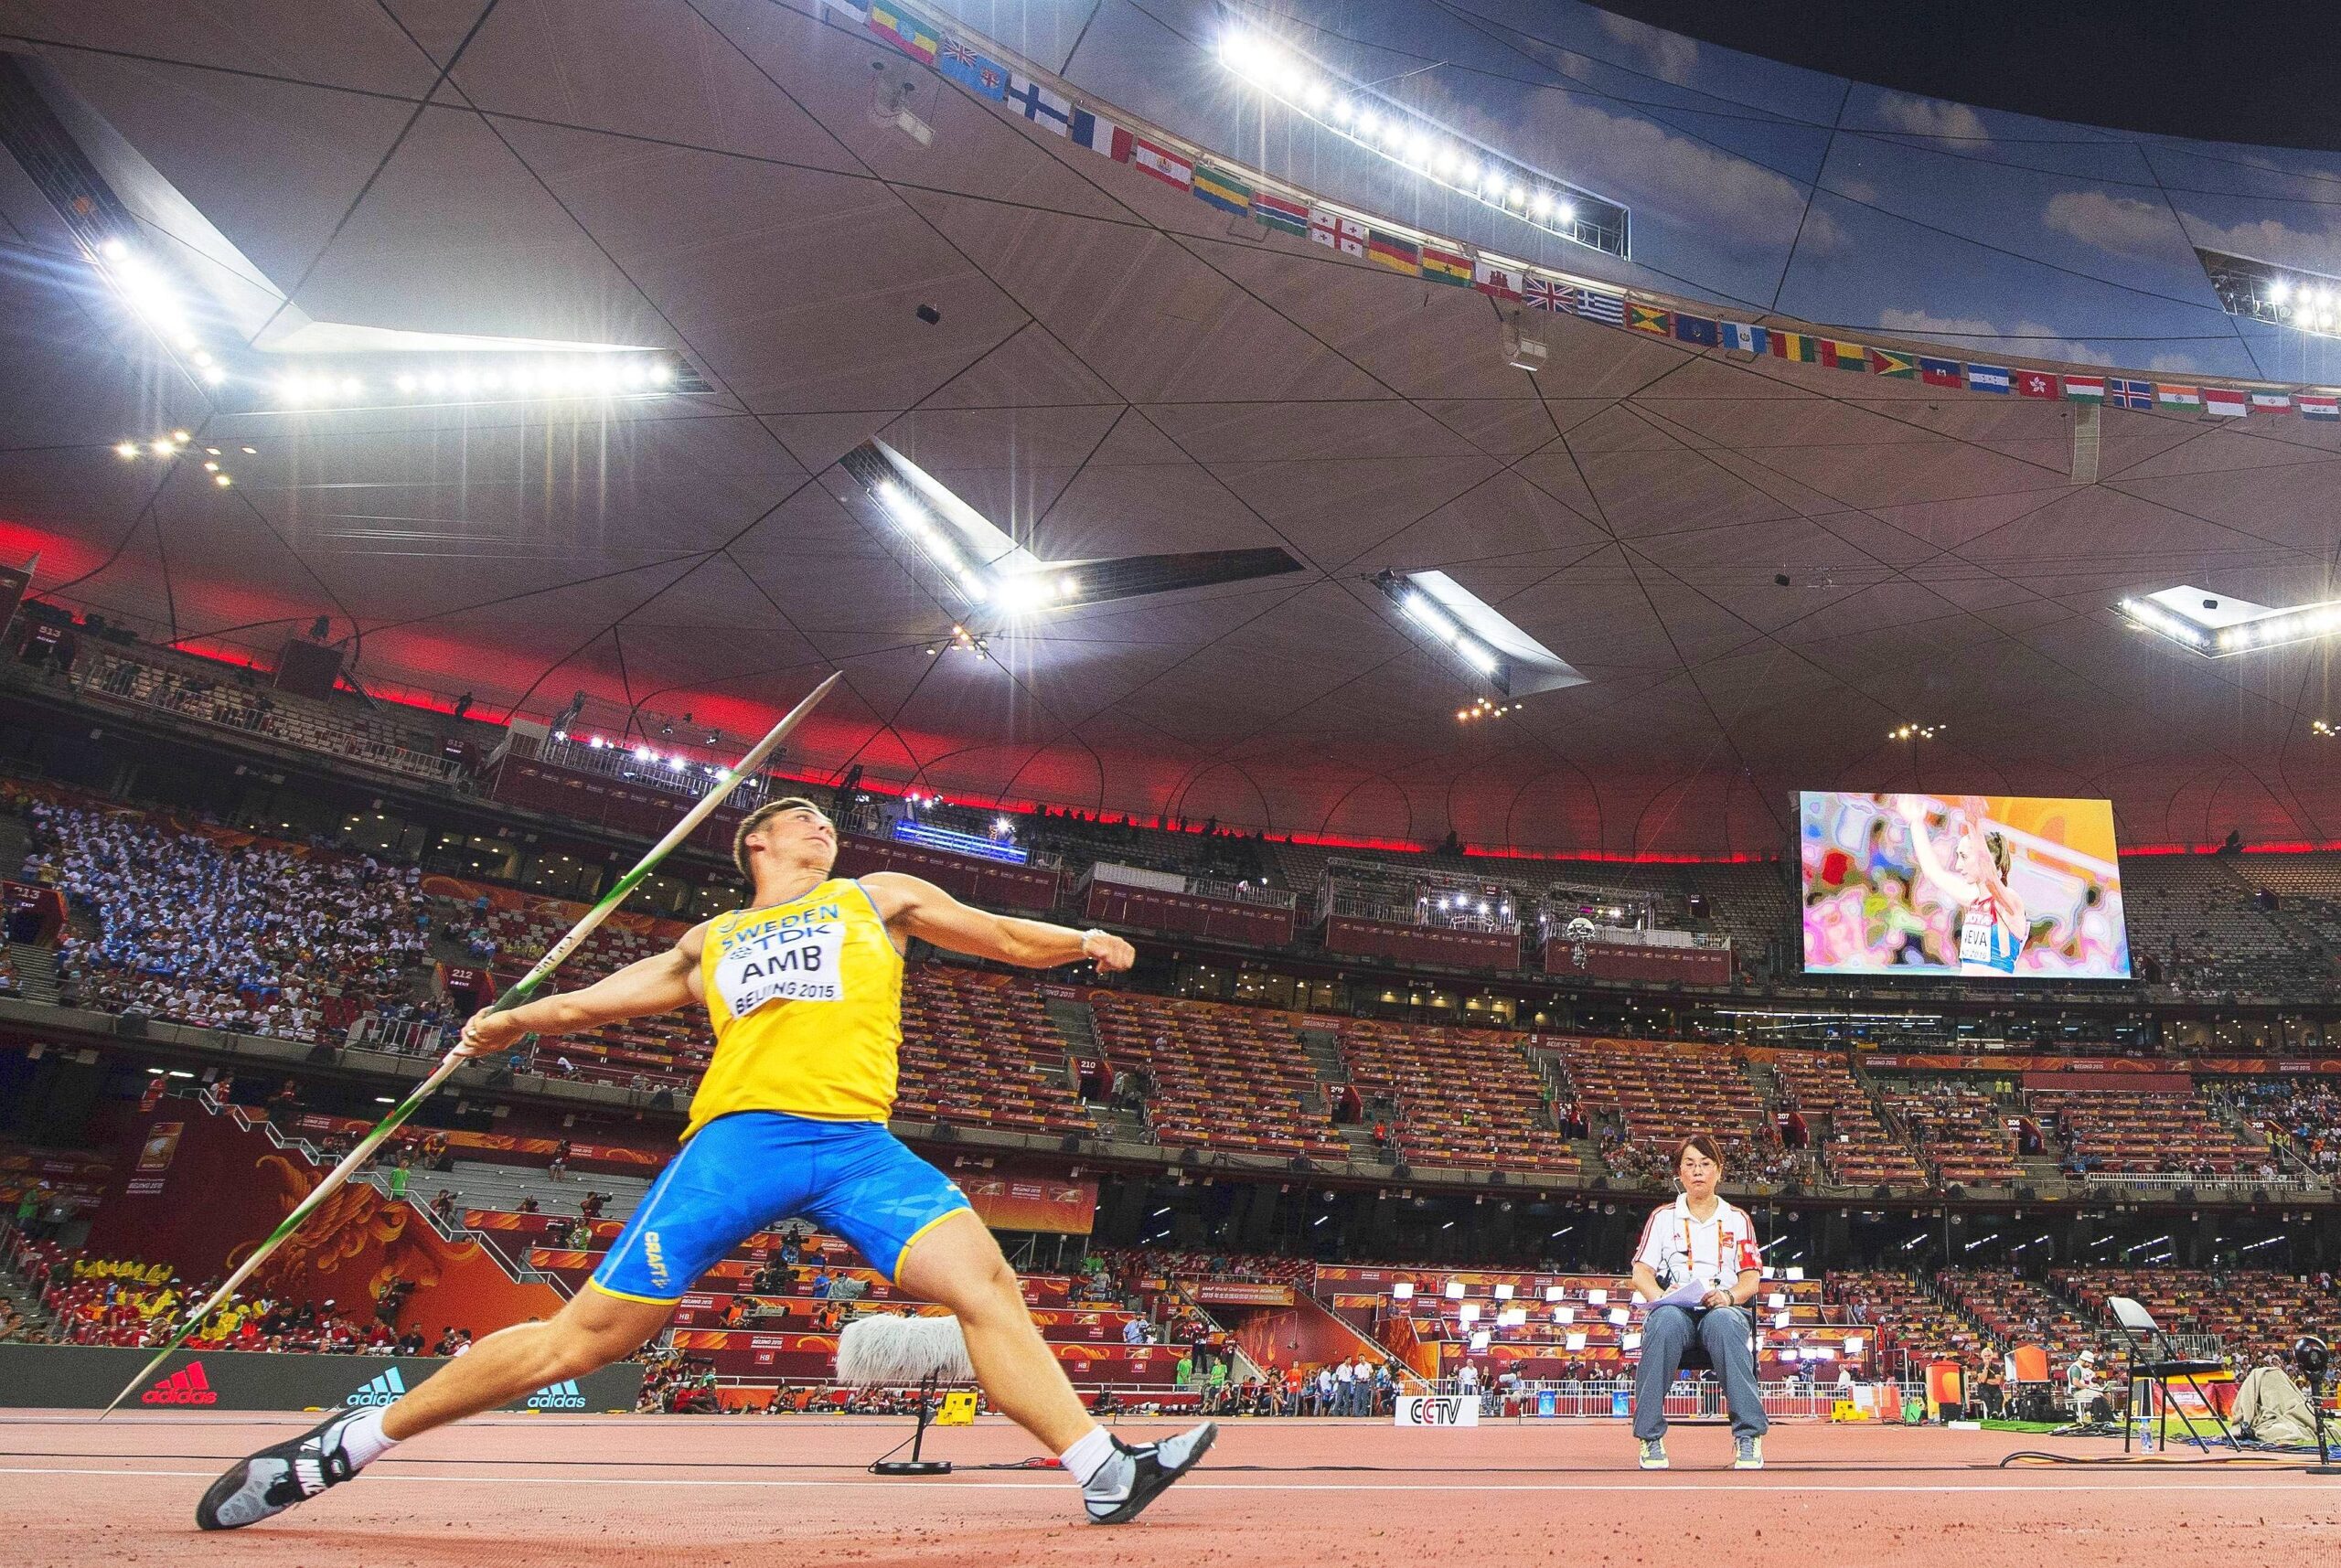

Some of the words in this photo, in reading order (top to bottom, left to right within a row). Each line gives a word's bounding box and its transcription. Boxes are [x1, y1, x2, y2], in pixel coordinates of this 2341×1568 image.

[721, 903, 839, 950] SWEDEN
[753, 923, 831, 952] TDK
[452, 968, 474, 979] 212
[741, 945, 822, 985] AMB
[797, 983, 835, 999] 2015
[1081, 1061, 1096, 1069] 210
[142, 1387, 218, 1404] adidas
[347, 1392, 402, 1406] adida
[528, 1394, 586, 1408] adidas
[1411, 1398, 1461, 1424] CCTV
[295, 1459, 326, 1496] NIKE
